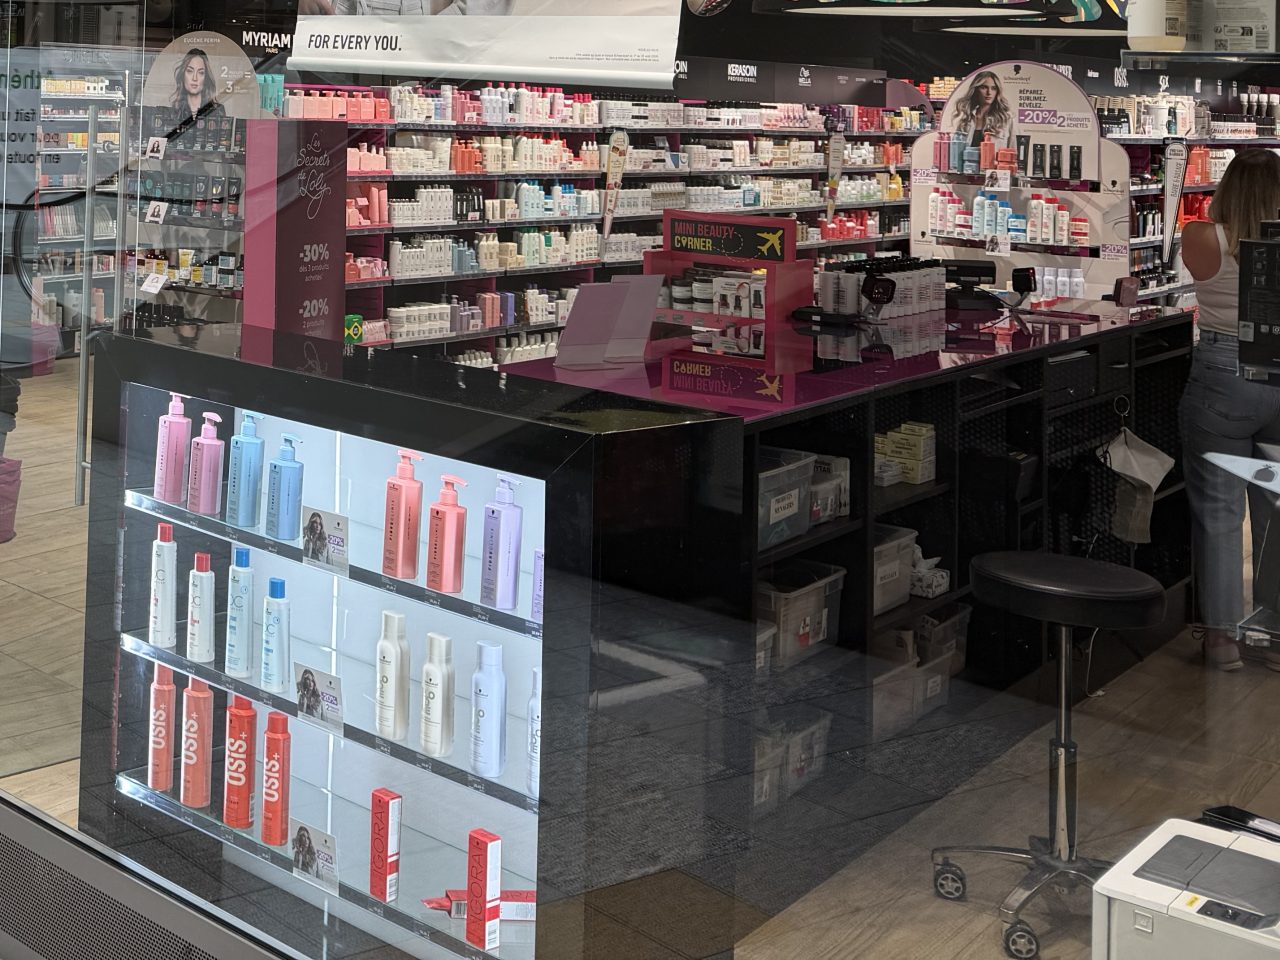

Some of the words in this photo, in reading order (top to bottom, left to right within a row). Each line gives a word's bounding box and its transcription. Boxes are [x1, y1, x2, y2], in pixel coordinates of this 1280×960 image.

[242, 31, 291, 48] MYRIAM
[307, 34, 331, 50] FOR
[332, 34, 371, 51] EVERY
[373, 35, 402, 51] YOU.
[220, 66, 228, 78] 2
[727, 63, 757, 77] KERASOIN
[225, 81, 233, 93] 3
[1019, 111, 1057, 124] -20%
[1057, 115, 1066, 127] 2
[306, 132, 321, 153] Les
[296, 148, 330, 167] Secrets
[299, 169, 331, 220] Loly
[675, 221, 695, 235] MINI
[697, 223, 735, 239] BEAUTY
[299, 243, 330, 262] -30%
[1101, 244, 1127, 254] -20%
[299, 264, 307, 272] dès
[311, 263, 330, 272] produits
[298, 298, 329, 318] -20%
